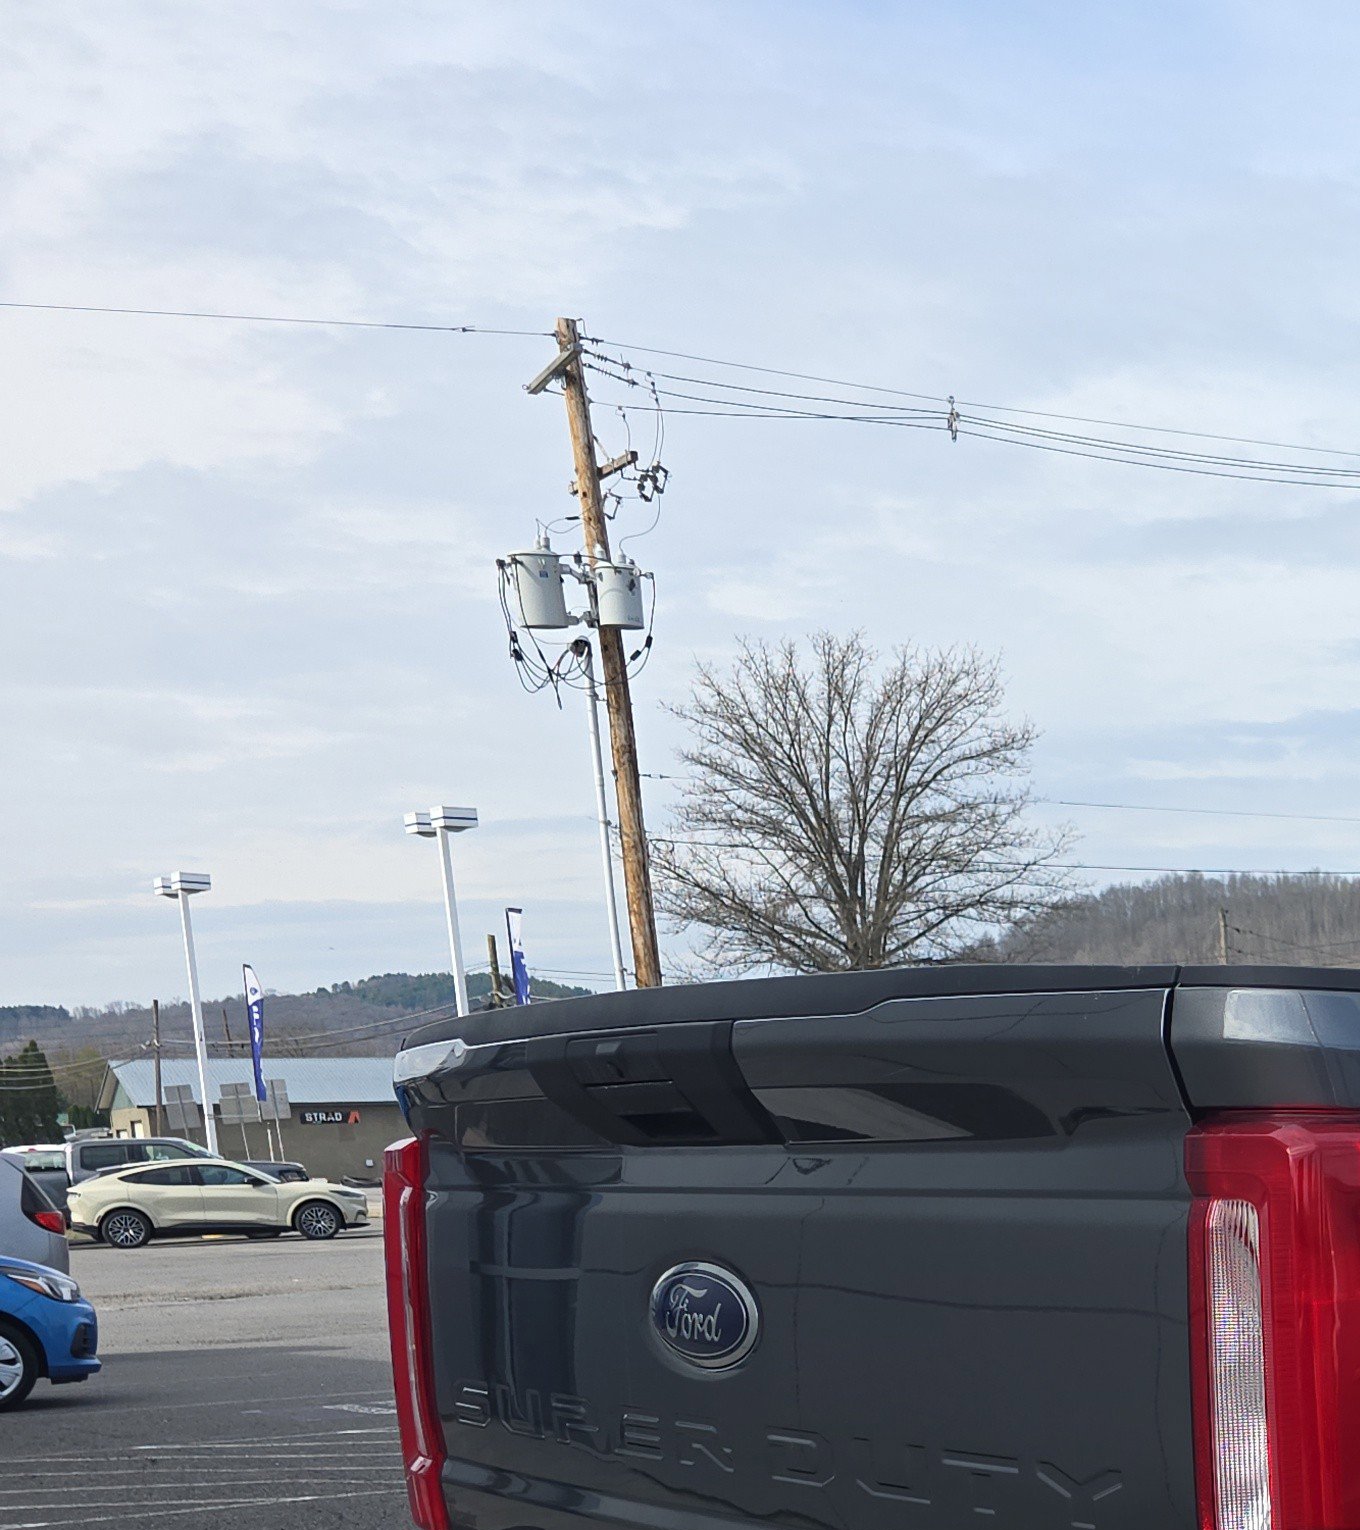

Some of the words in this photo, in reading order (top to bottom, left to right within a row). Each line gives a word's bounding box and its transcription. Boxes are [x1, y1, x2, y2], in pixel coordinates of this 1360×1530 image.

[305, 1112, 343, 1122] STRAD
[664, 1285, 722, 1342] Ford
[454, 1382, 735, 1473] SUPER
[765, 1427, 1124, 1530] DUTY
